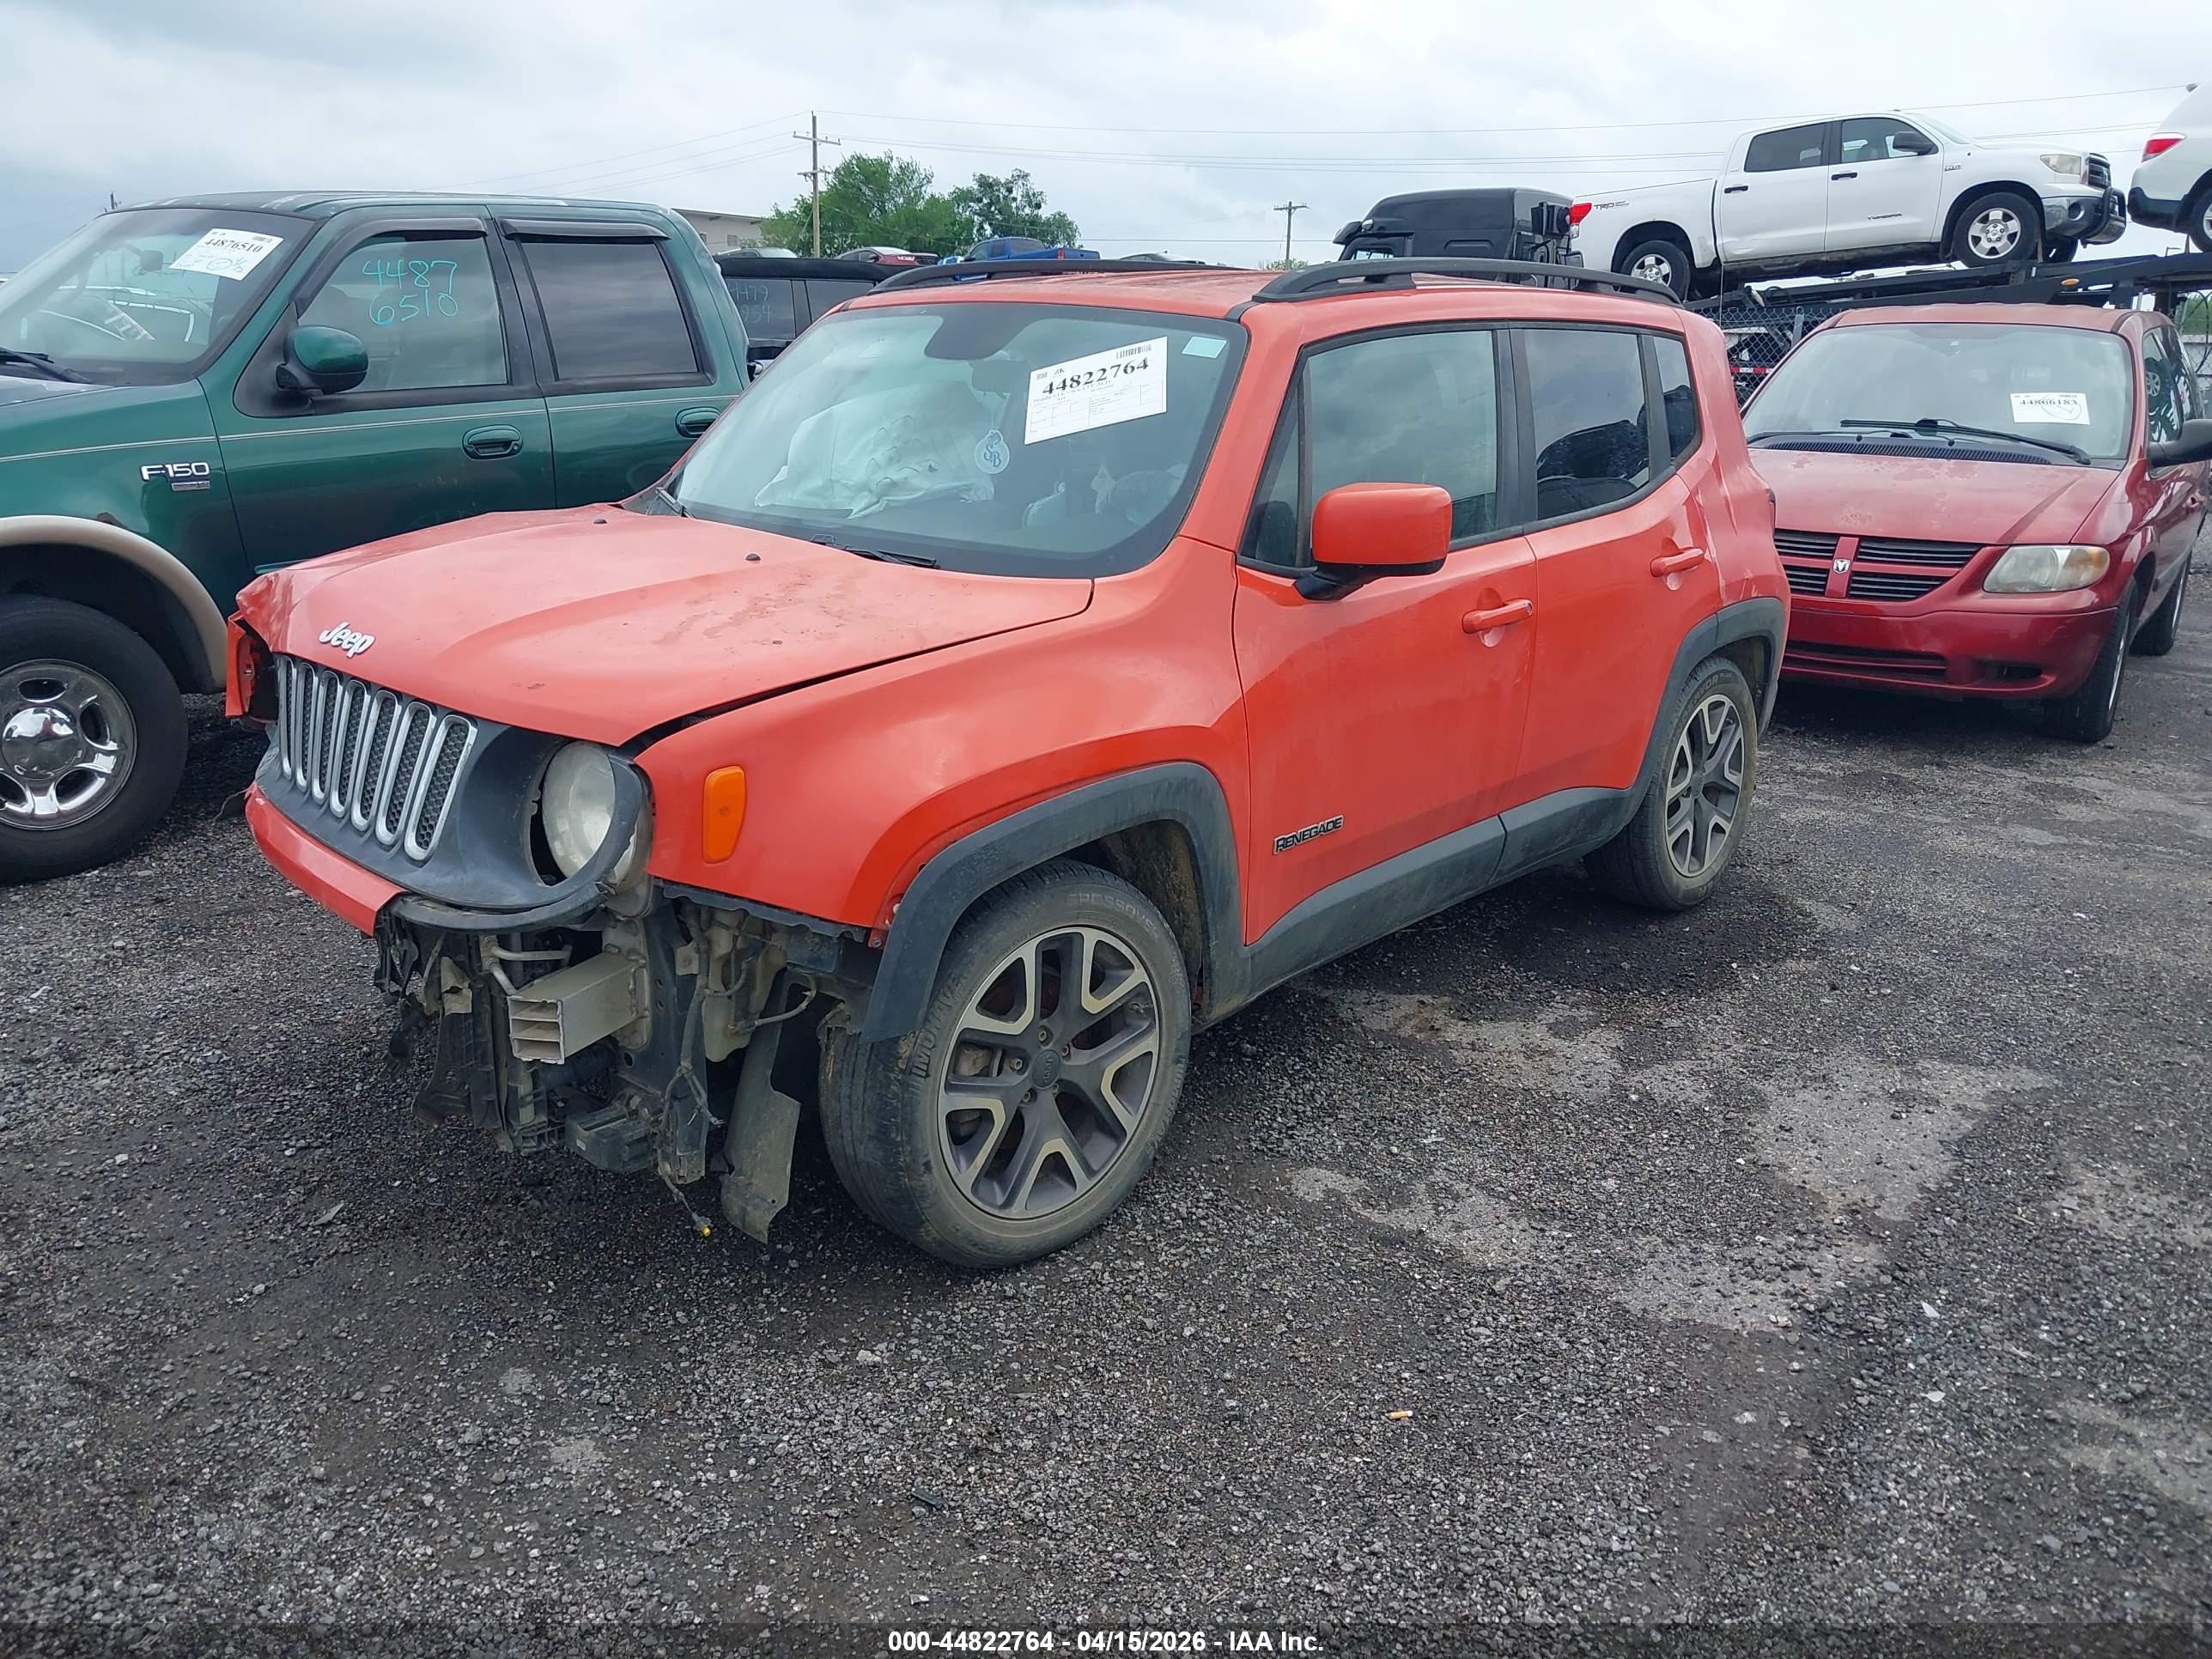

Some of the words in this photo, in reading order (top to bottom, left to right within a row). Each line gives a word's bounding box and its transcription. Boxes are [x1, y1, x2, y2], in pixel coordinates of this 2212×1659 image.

[204, 237, 263, 253] 44876510
[362, 259, 458, 295] 4487
[368, 289, 459, 325] 6510
[1042, 356, 1150, 395] 44822764
[141, 462, 210, 481] F-150
[319, 621, 376, 659] Jeep
[1273, 815, 1344, 854] RENEGADE
